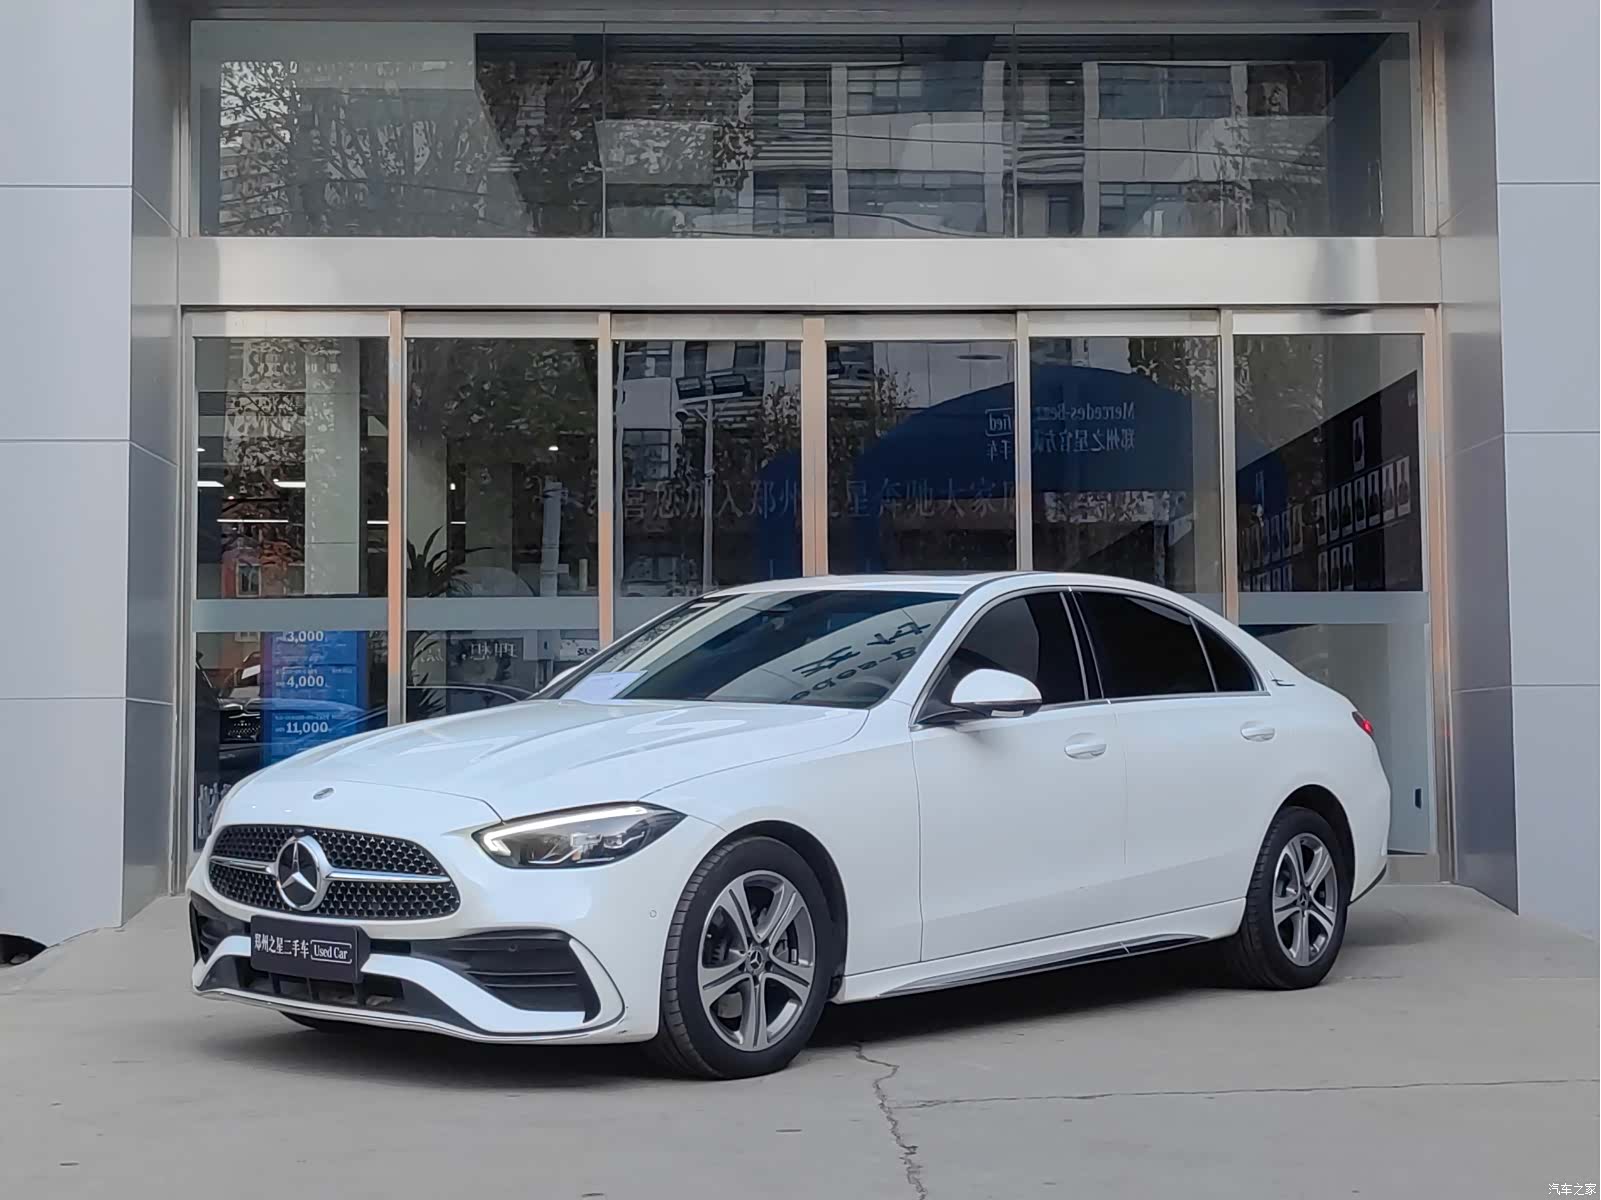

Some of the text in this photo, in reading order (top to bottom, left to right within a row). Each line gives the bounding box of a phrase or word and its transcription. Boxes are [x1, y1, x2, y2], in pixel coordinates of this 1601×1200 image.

[286, 675, 324, 688] 4,000
[286, 721, 329, 735] 11,000
[254, 933, 309, 959] 郑州之星二手车
[314, 944, 348, 959] Used Car
